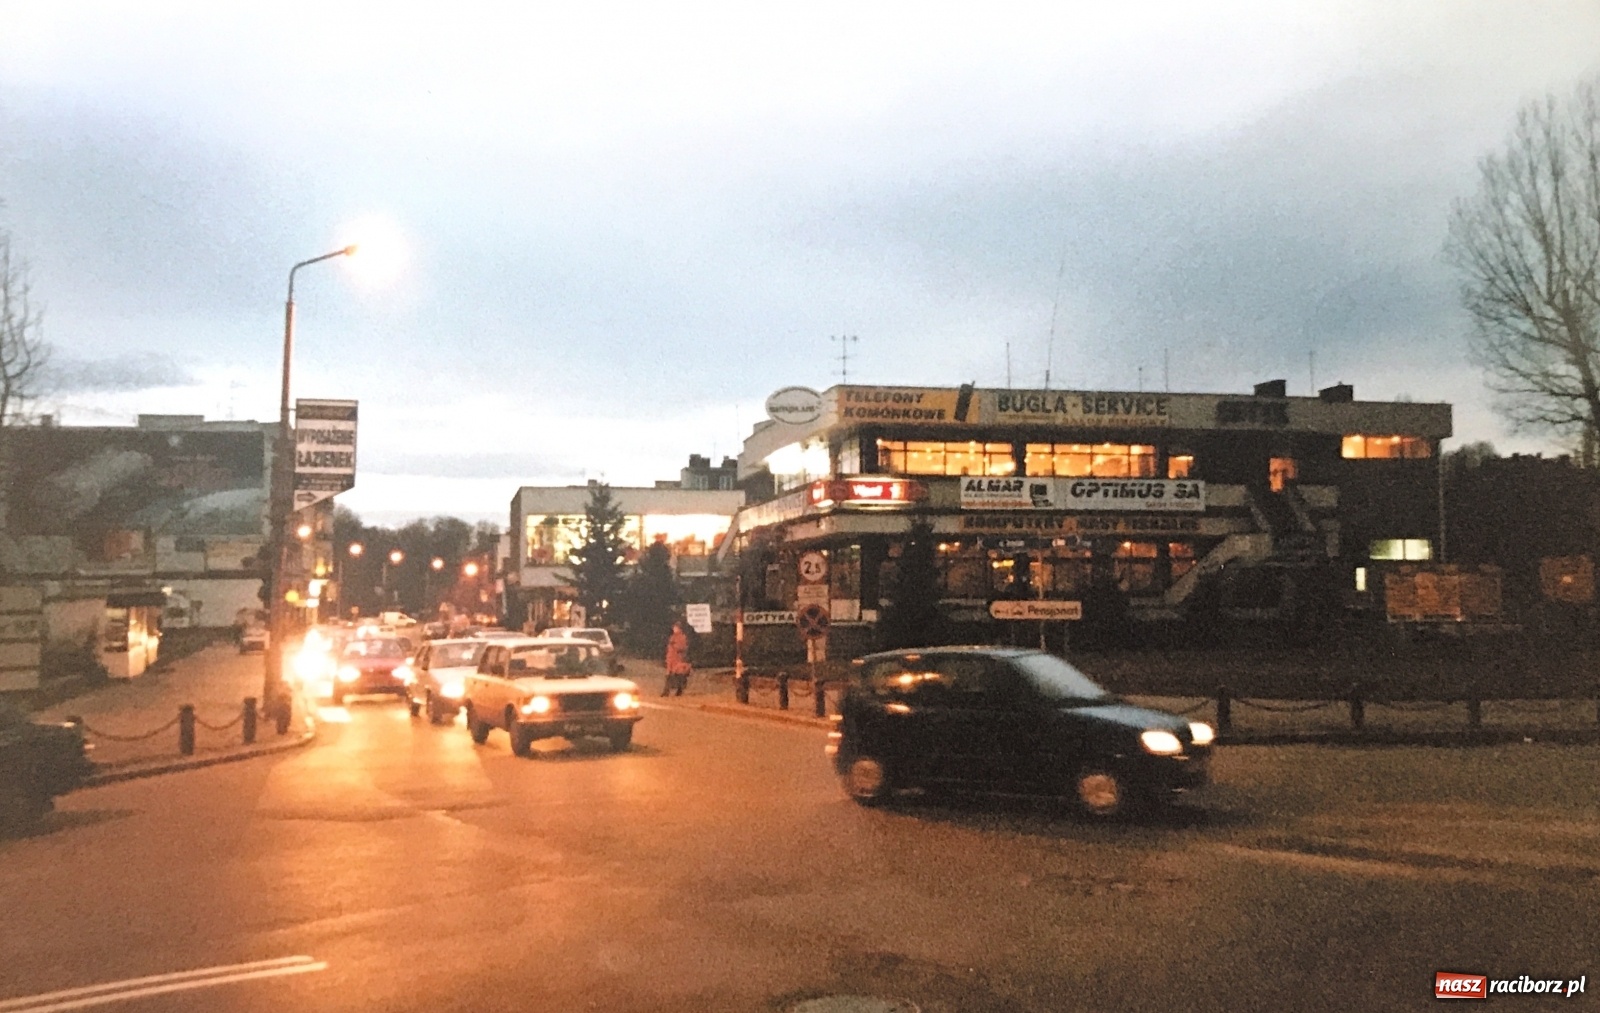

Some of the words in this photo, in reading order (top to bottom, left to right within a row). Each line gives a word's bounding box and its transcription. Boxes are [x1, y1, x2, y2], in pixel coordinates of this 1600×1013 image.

[844, 391, 924, 404] TELEFONY
[998, 393, 1067, 414] BUGLA
[1082, 396, 1167, 416] SERVICE
[297, 450, 353, 468] ŁAZIENEK
[965, 479, 1024, 492] ALMAR
[1070, 482, 1165, 499] OPTIMUS
[1174, 483, 1200, 499] SA
[746, 612, 794, 622] OPTYKA
